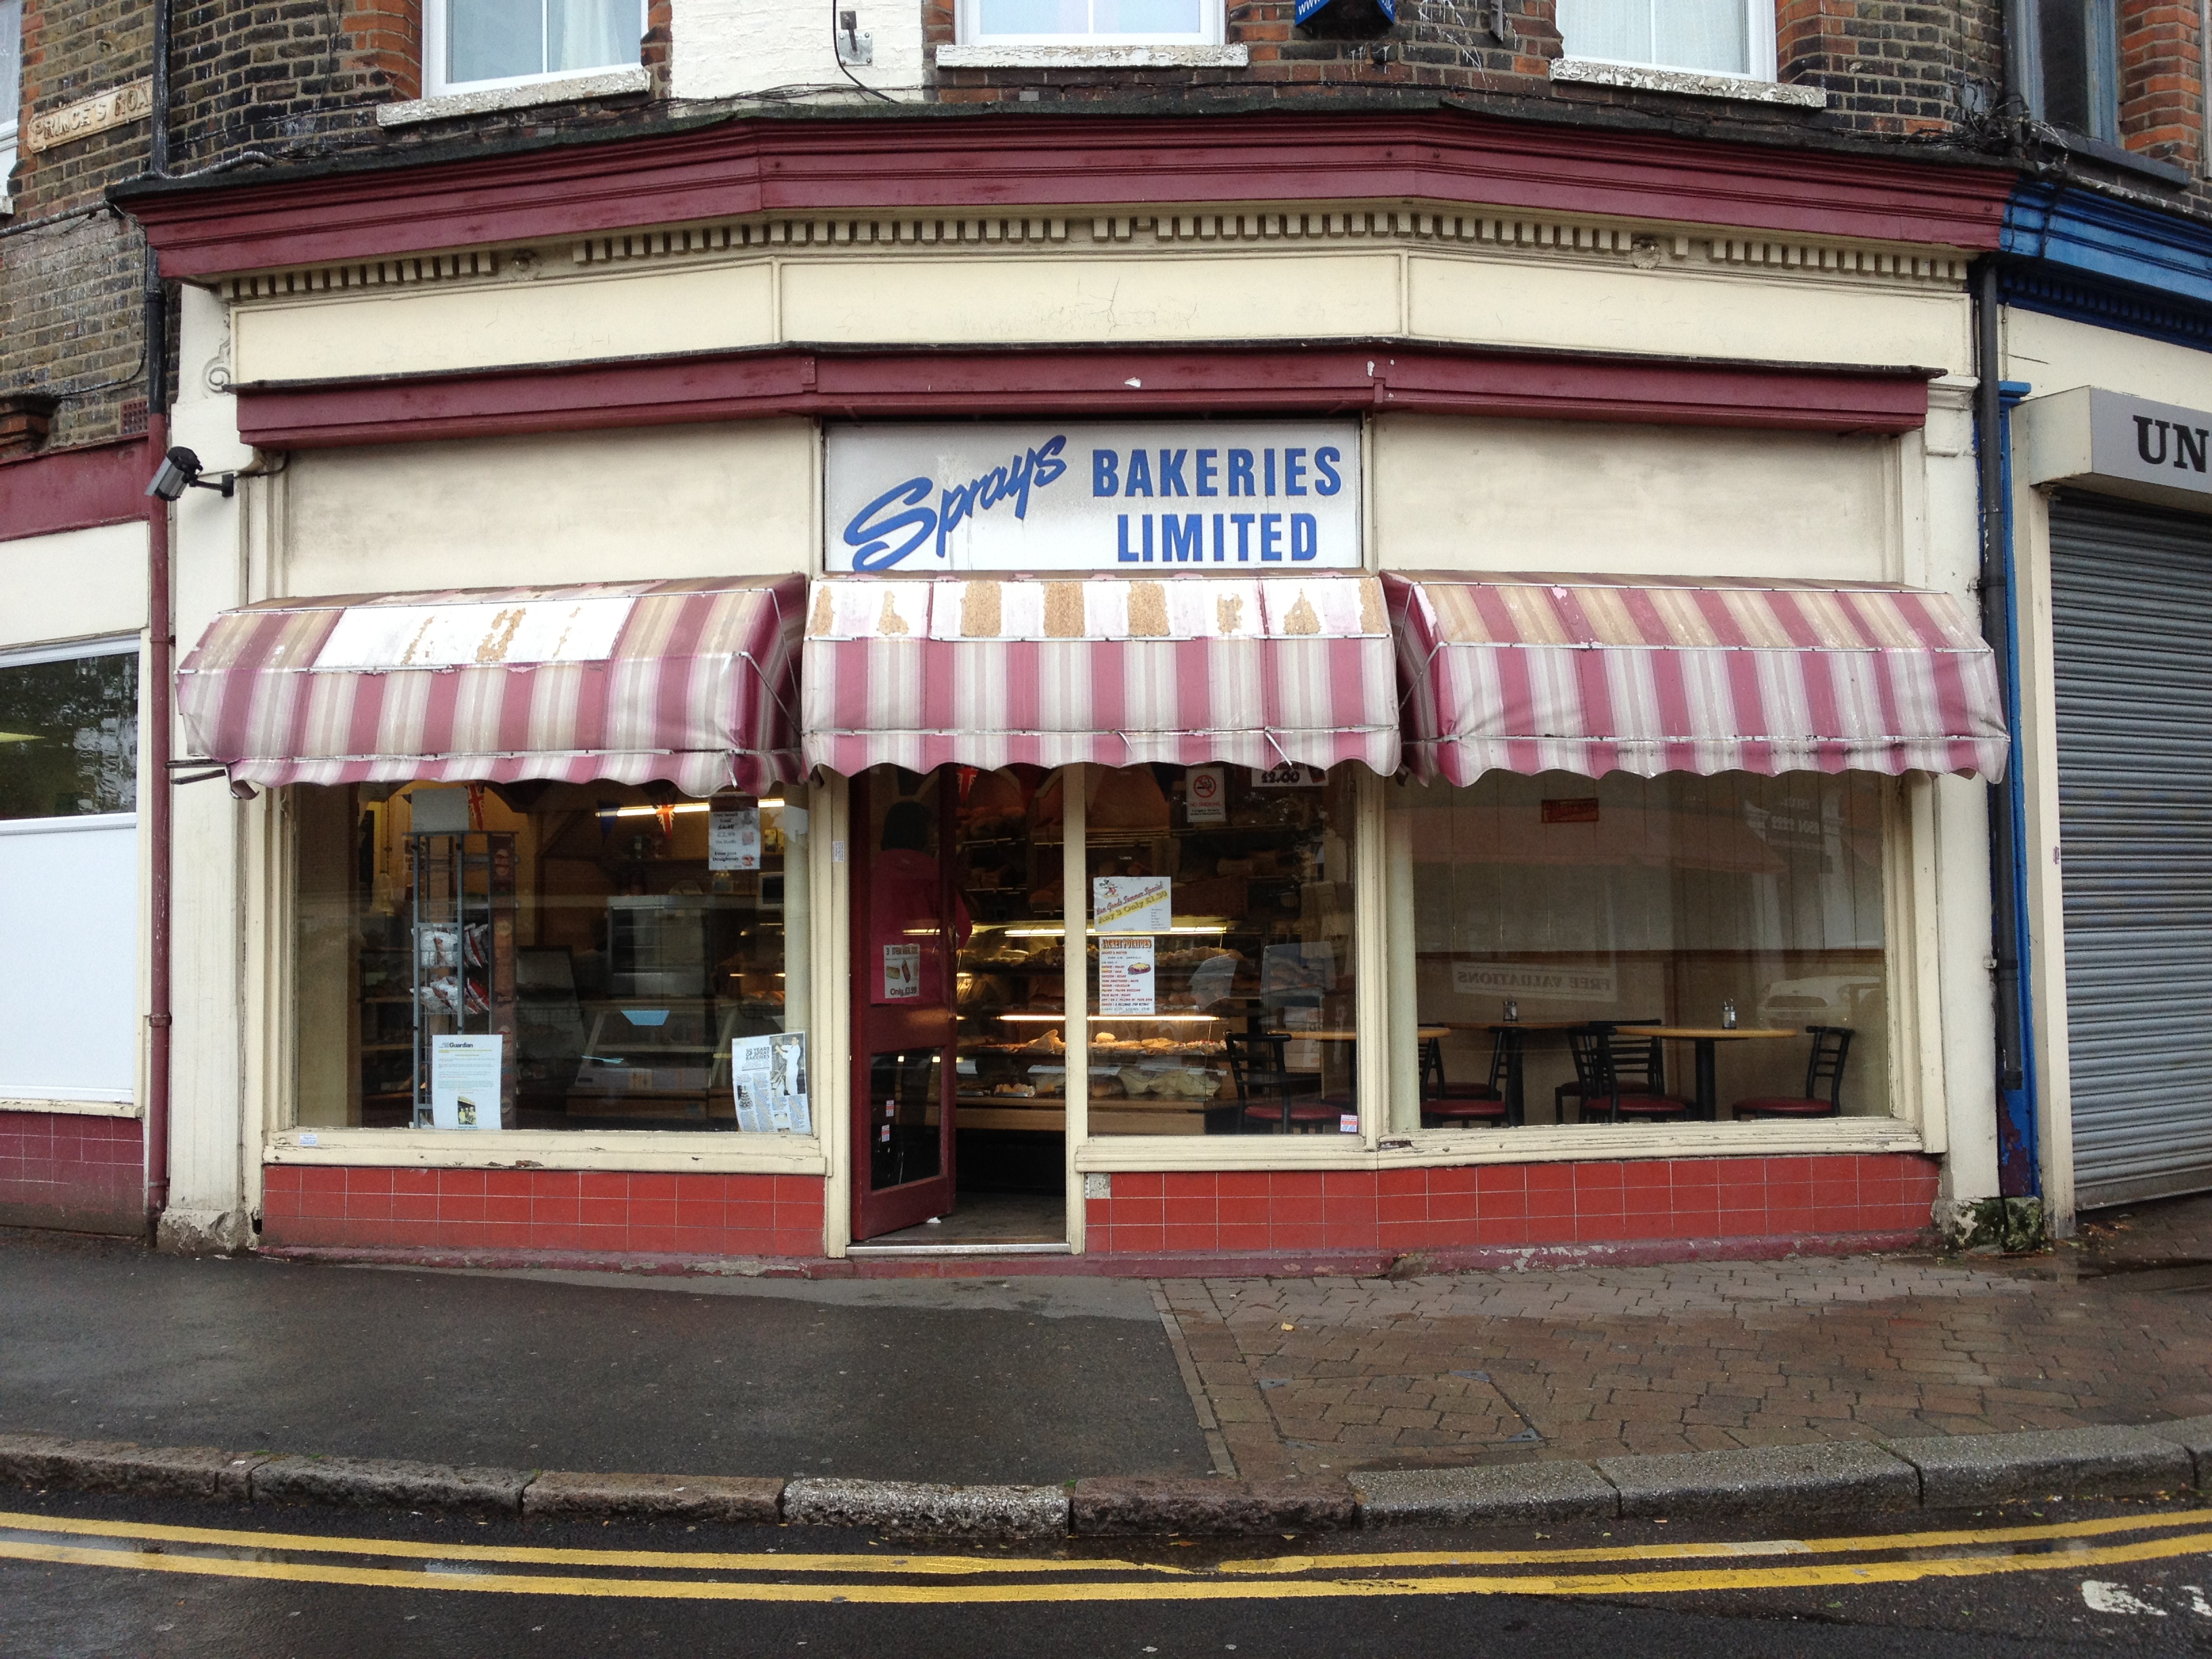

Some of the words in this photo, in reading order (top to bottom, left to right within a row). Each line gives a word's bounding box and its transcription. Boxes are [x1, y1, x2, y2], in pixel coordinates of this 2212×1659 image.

[32, 102, 108, 143] PRINCE'S
[115, 82, 153, 117] ROA
[843, 434, 1067, 571] Sprays
[1092, 446, 1342, 497] BAKERIES
[1117, 512, 1317, 562] LIMITED
[1144, 880, 1164, 897] Special
[1098, 913, 1115, 924] Any
[1124, 900, 1144, 913] Only
[1102, 939, 1123, 949] JACKET
[1123, 939, 1152, 949] POTATOES
